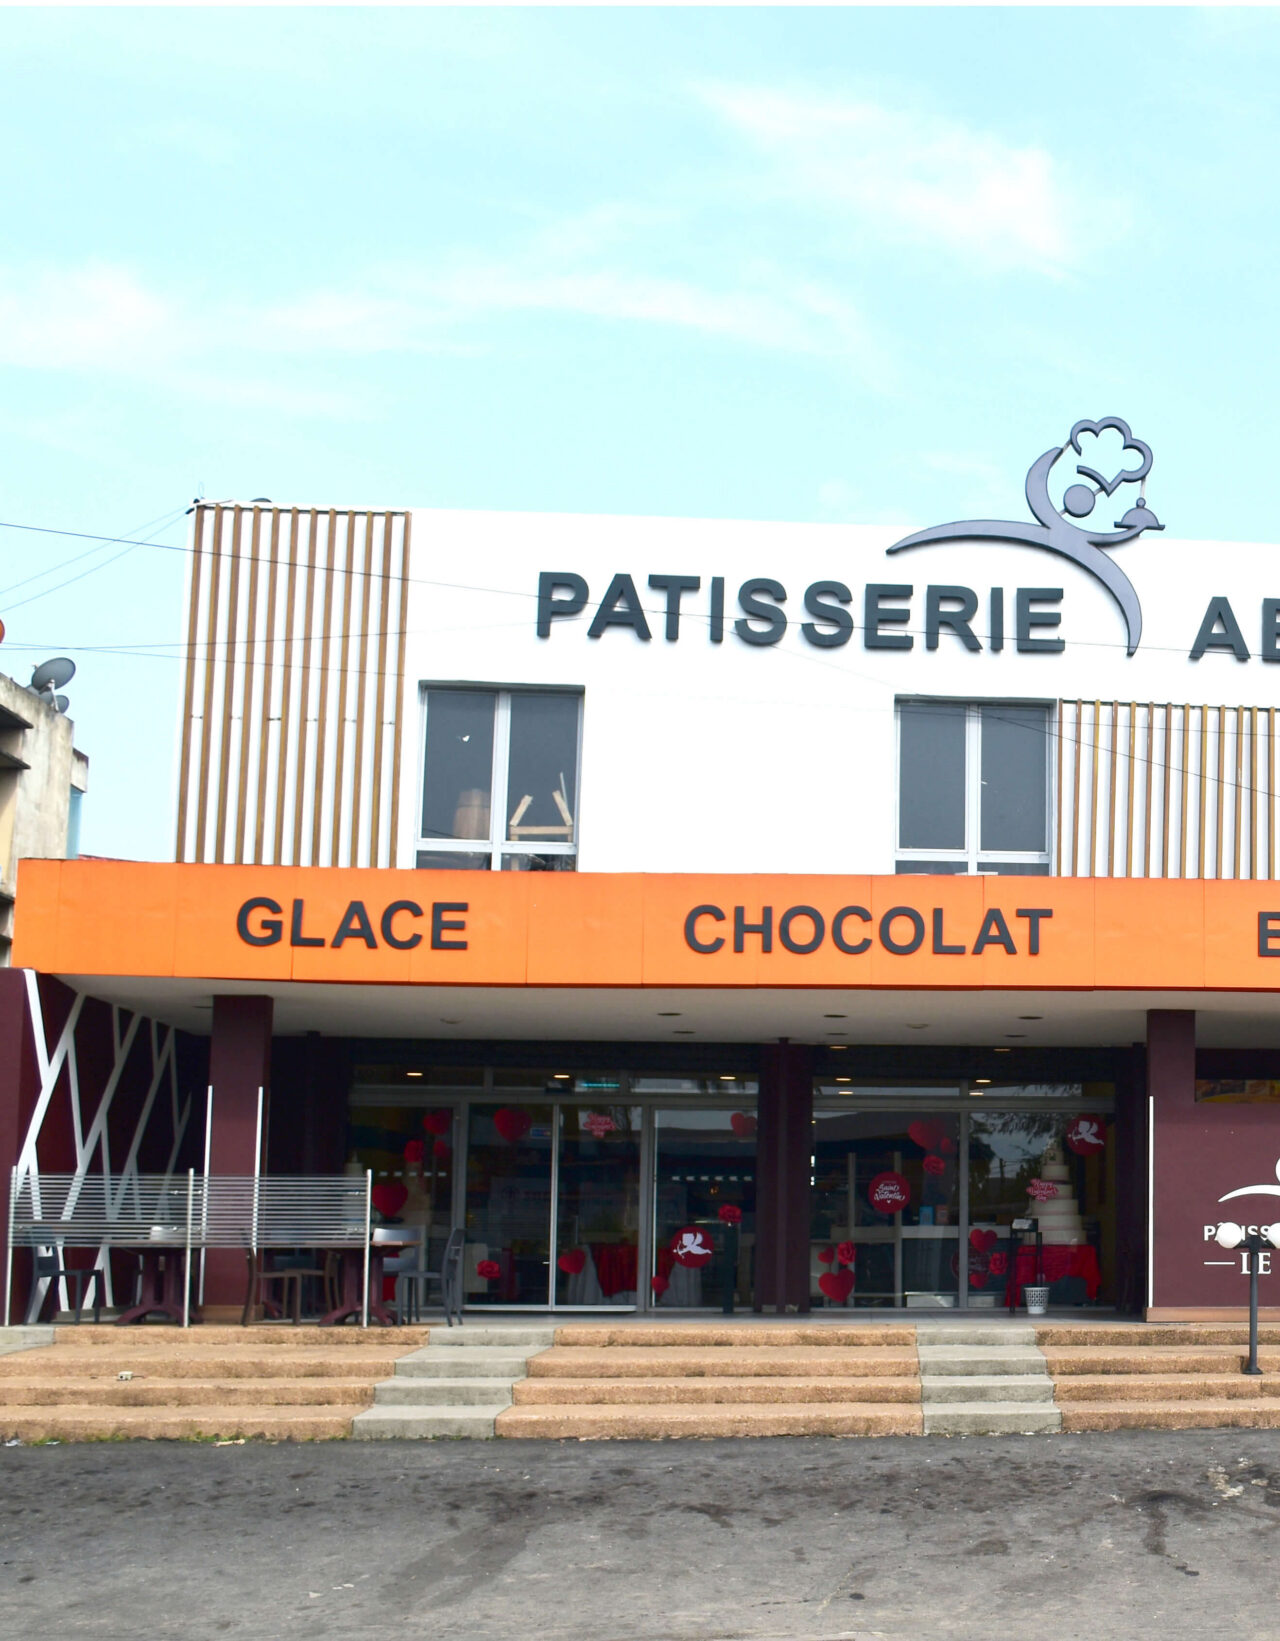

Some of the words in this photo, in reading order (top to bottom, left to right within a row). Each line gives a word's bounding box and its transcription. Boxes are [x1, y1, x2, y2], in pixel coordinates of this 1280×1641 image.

[537, 572, 1066, 654] PATISSERIE
[237, 896, 469, 951] GLACE
[684, 904, 1053, 956] CHOCOLAT
